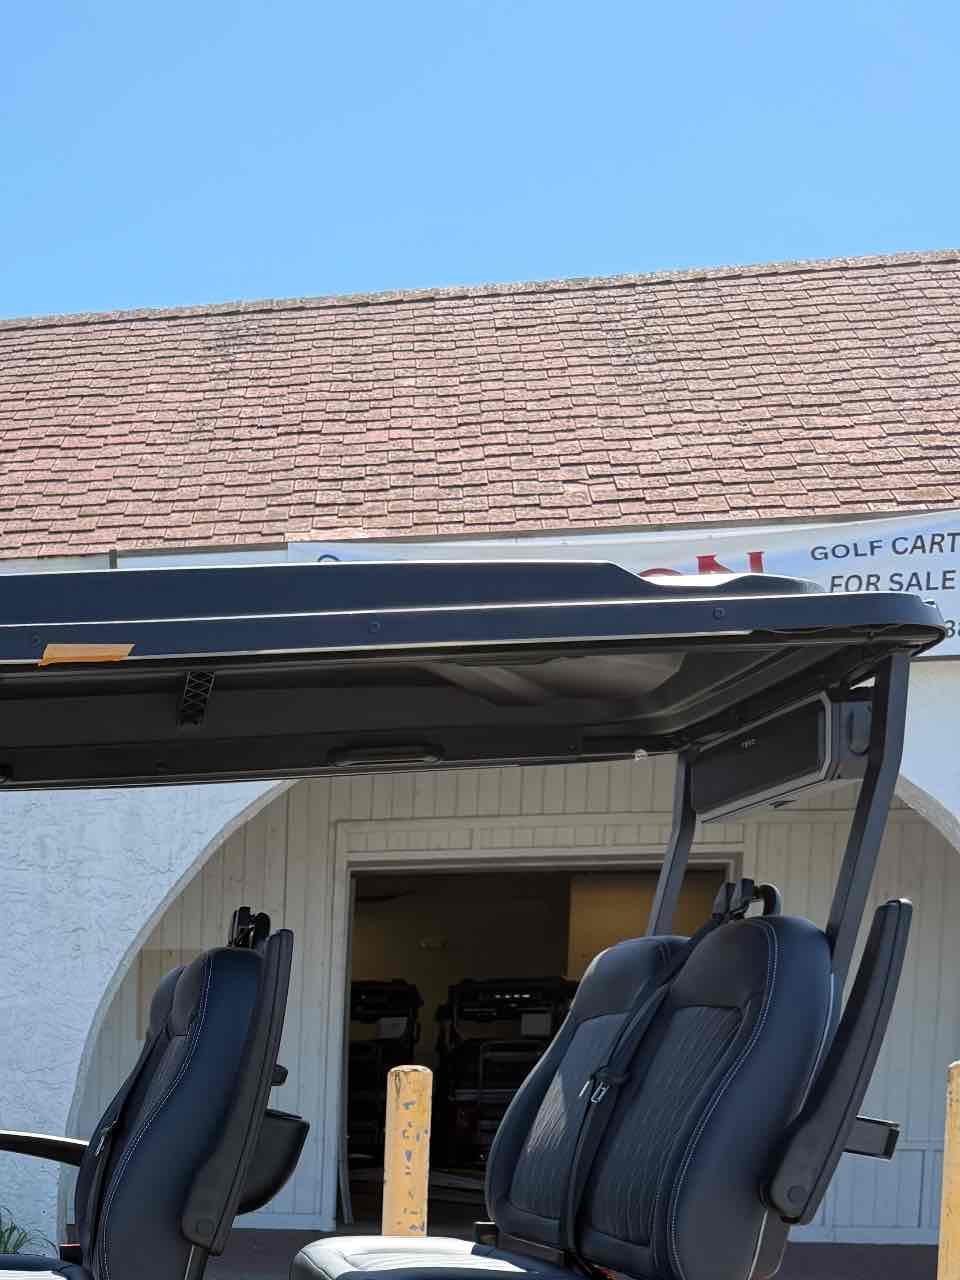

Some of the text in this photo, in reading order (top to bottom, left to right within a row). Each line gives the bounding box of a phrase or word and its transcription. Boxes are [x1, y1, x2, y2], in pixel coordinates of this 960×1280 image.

[810, 531, 960, 561] GOLF CART
[830, 569, 957, 593] FOR SALE
